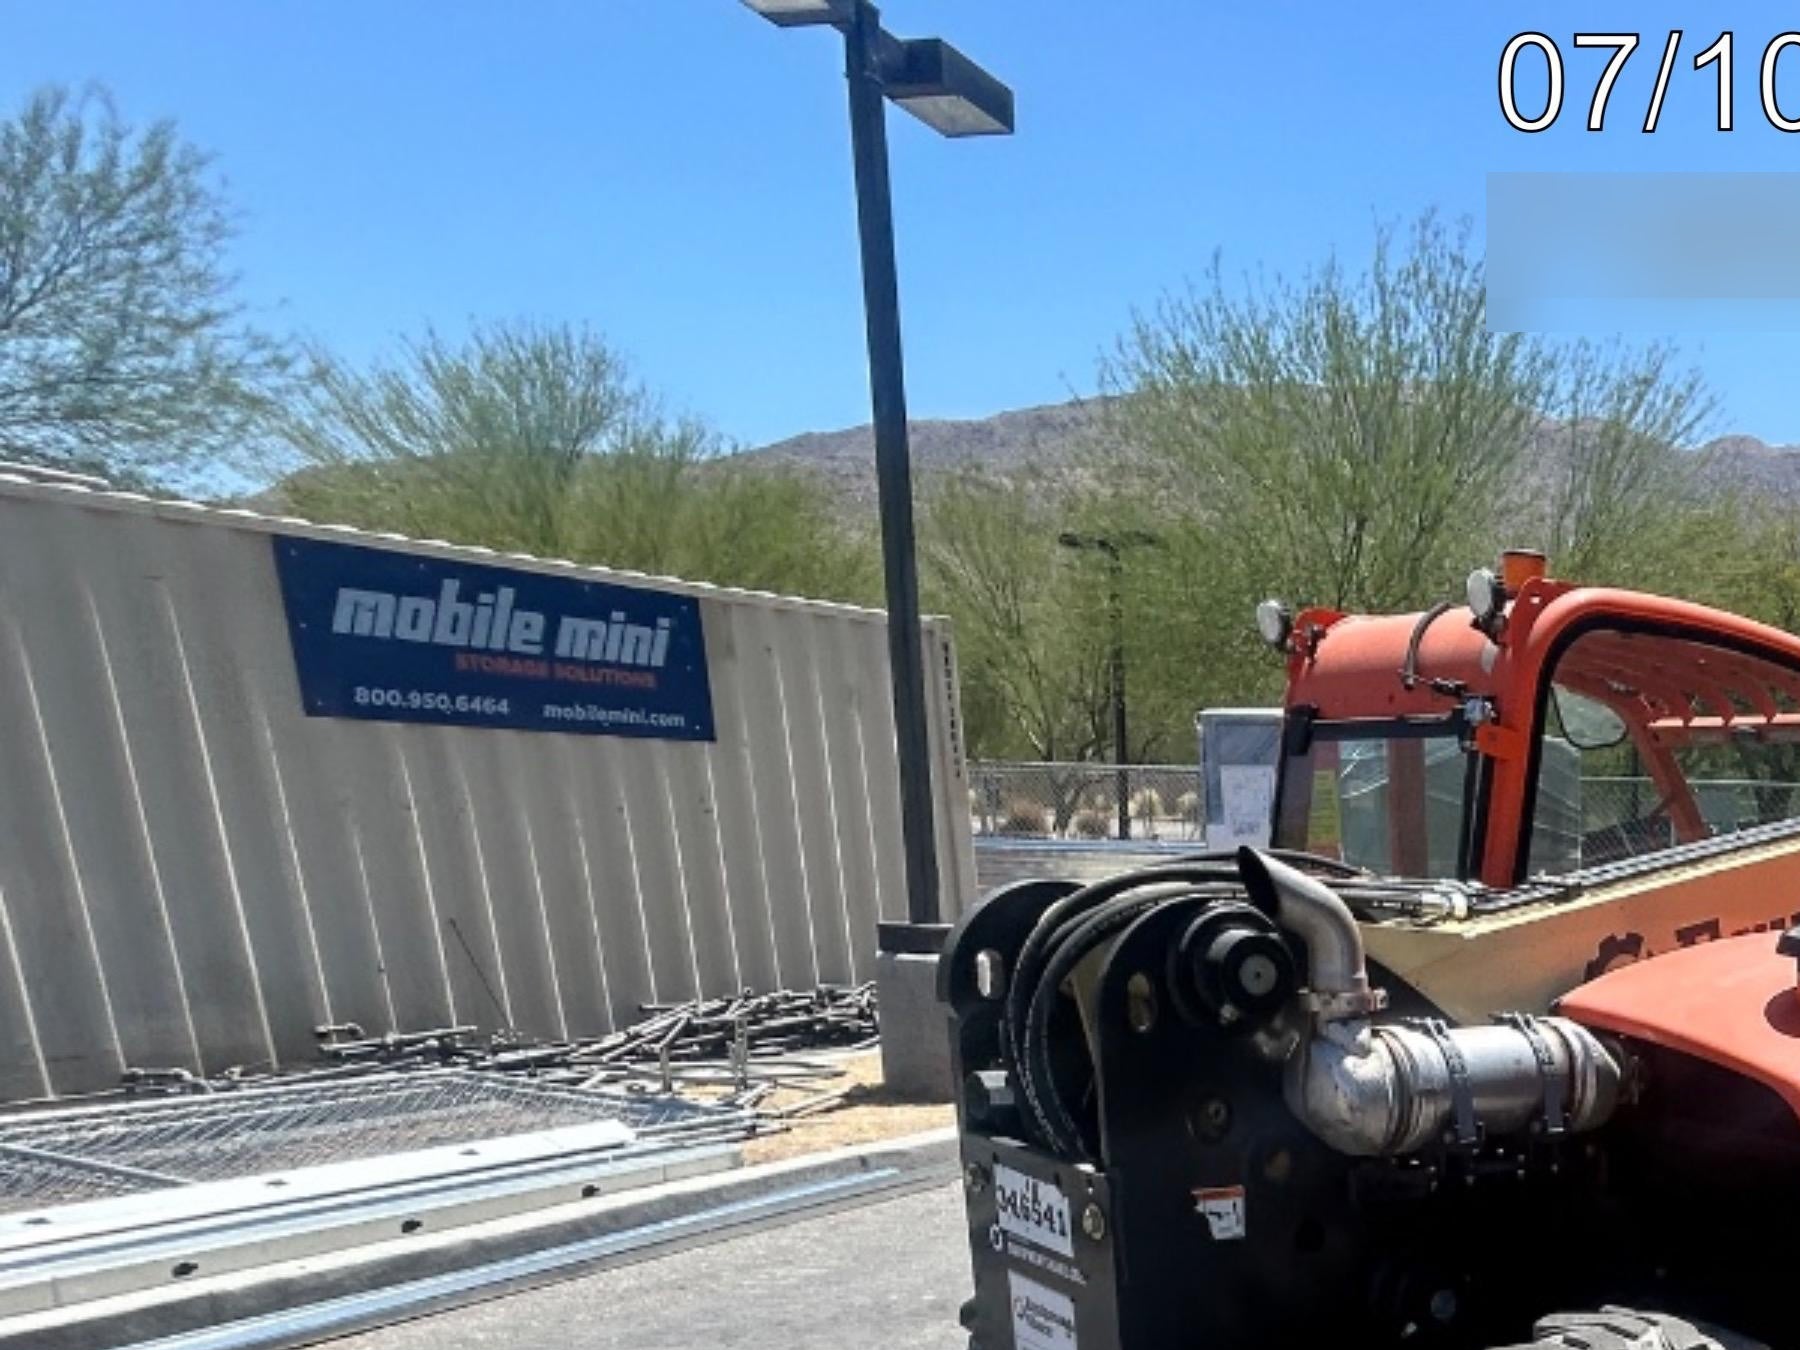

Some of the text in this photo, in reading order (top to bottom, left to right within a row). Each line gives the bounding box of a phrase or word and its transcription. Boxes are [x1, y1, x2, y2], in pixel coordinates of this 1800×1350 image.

[333, 578, 670, 668] mobile mini
[354, 685, 686, 729] 800.950.6464 mobilemini.com
